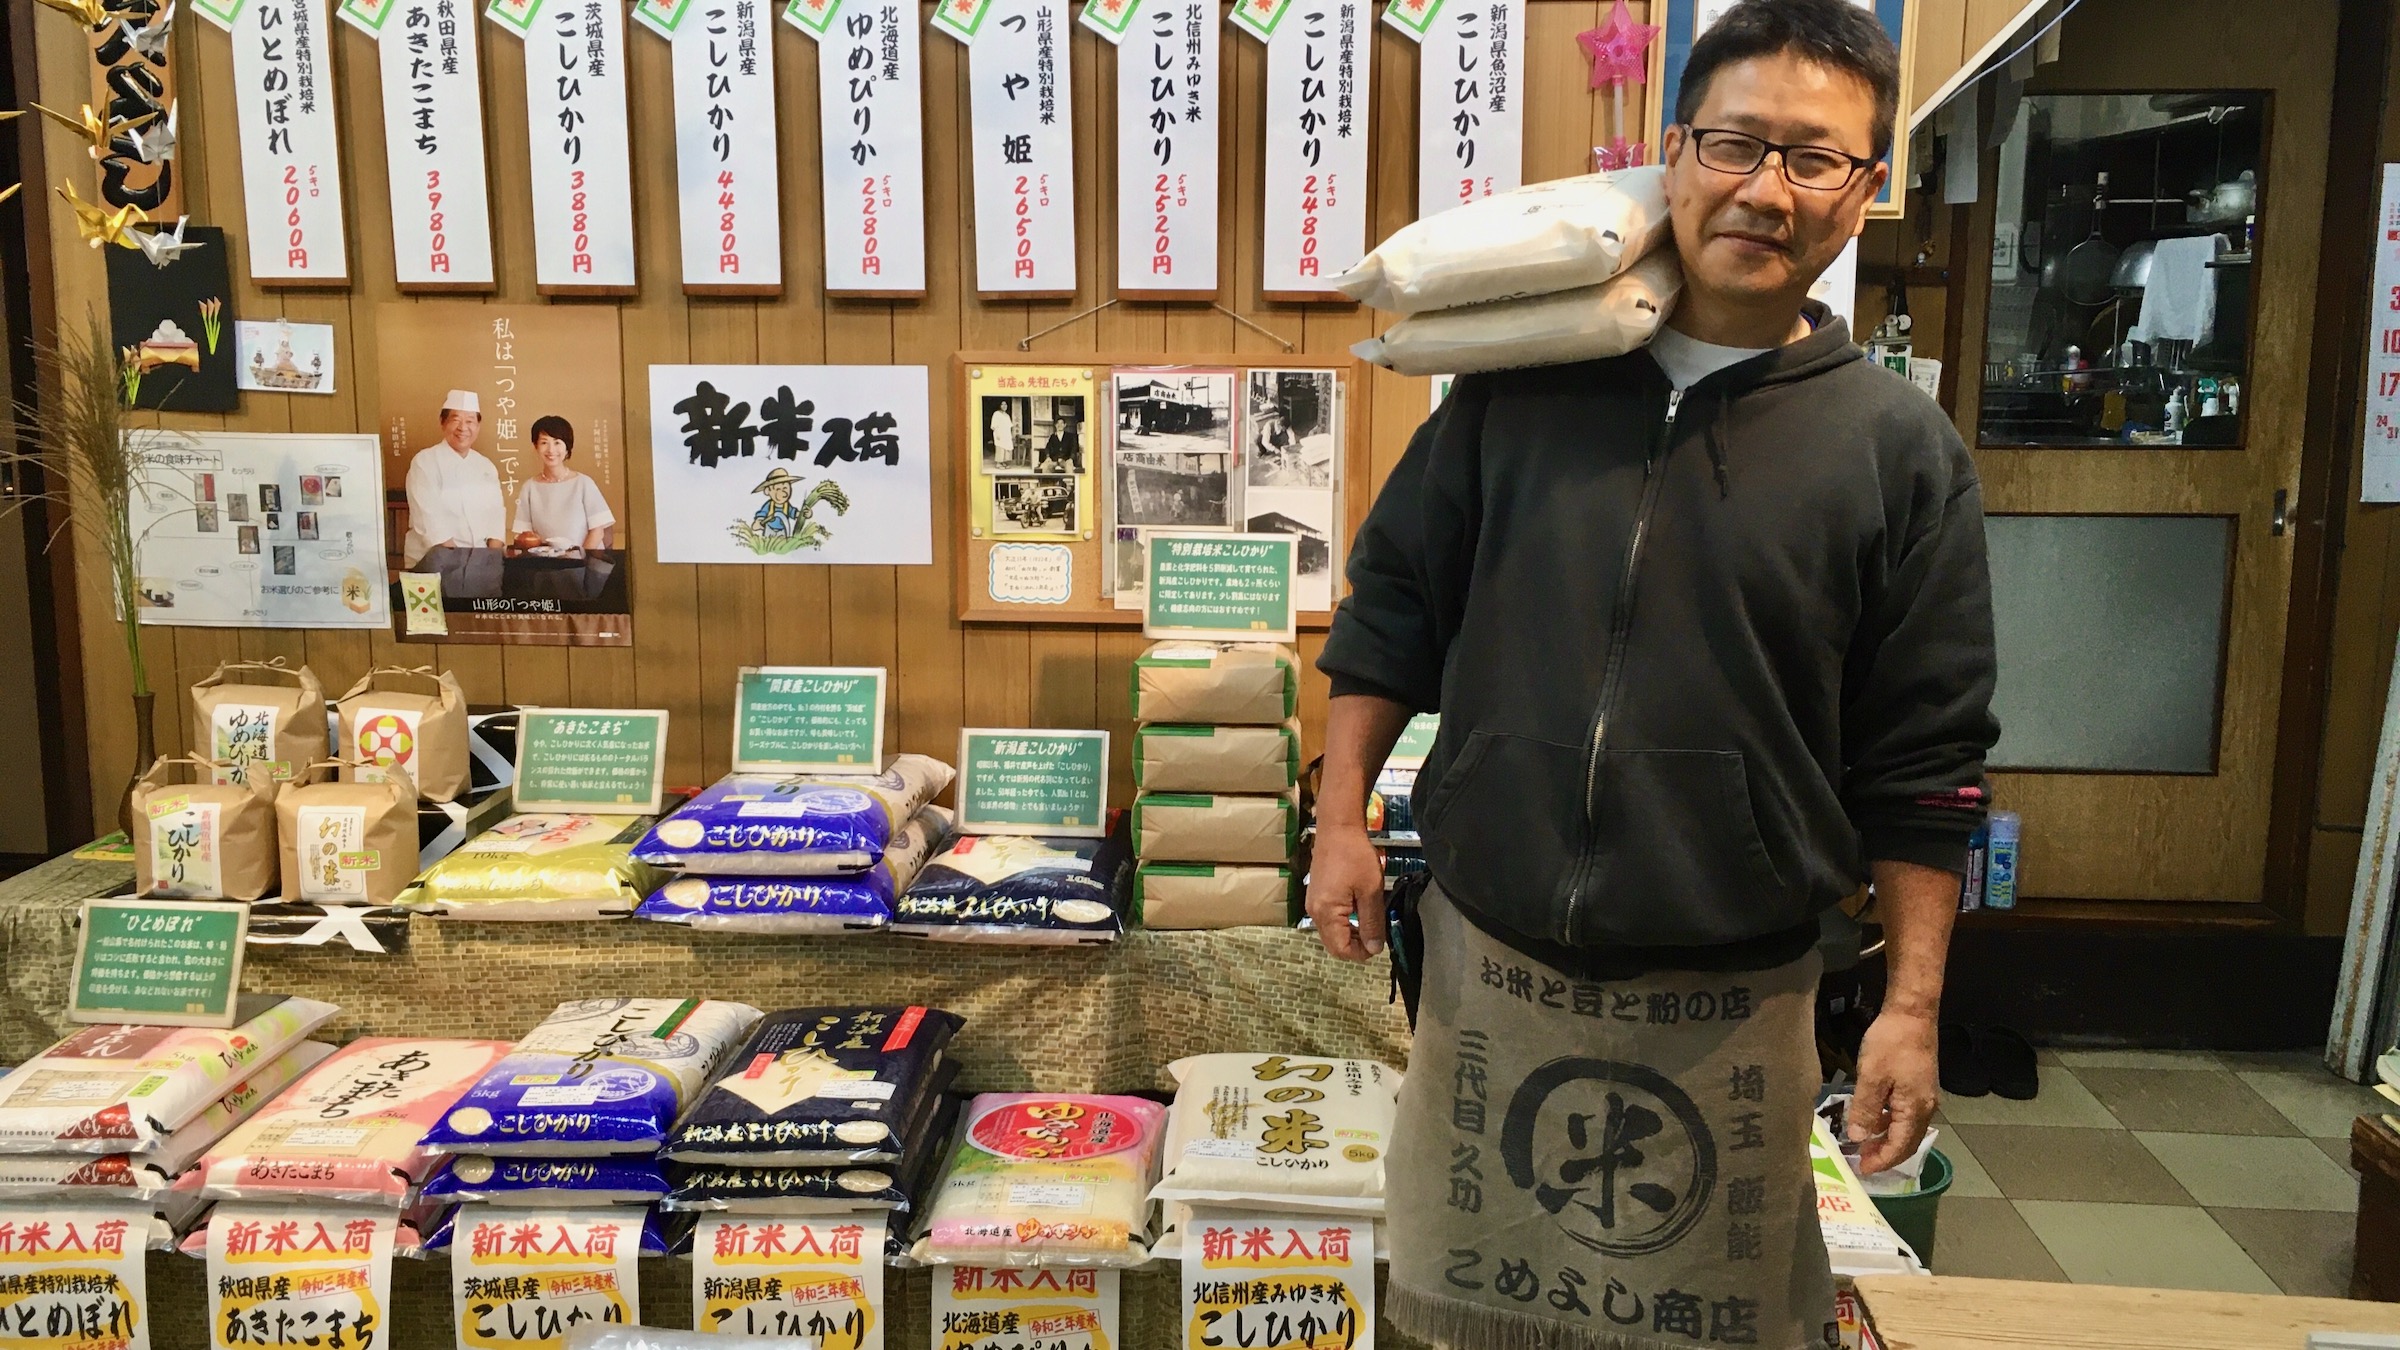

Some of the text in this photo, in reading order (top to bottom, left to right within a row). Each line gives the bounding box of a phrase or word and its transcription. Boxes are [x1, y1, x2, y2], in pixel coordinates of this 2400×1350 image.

[437, 0, 459, 74] 秋田県産
[584, 2, 605, 77] 茨城県産
[736, 1, 757, 76] 新潟県産
[880, 5, 900, 81] 北海道産
[1488, 4, 1509, 113] 新潟県魚沼産
[260, 5, 293, 154] ひとめぼれ
[406, 7, 438, 155] あきたこまち
[555, 11, 584, 165] こしひかり
[704, 8, 734, 162] こしひかり
[1036, 5, 1056, 126] 山形県産特別栽培米
[1184, 3, 1203, 123] 北信州みゆき米
[1337, 4, 1356, 138] 新潟県産特別栽培米
[846, 11, 878, 167] ゆめぴりか
[999, 13, 1032, 165] つや姫
[1149, 11, 1177, 168] こしひかり
[1300, 11, 1327, 168] こしひかり
[1455, 11, 1481, 169] こしひかり
[308, 165, 320, 197] 5キロ
[881, 174, 893, 208] 5キロ
[1038, 173, 1050, 208] 5キロ
[1177, 173, 1188, 209] 5キロ
[283, 165, 308, 269] 2060円
[427, 171, 450, 273] 3980円
[570, 170, 592, 274] 3880円
[717, 170, 739, 274] 4480円
[862, 177, 881, 276] 2280円
[1014, 174, 1034, 280] 2650円
[1152, 173, 1172, 276] 2520円
[1300, 174, 1320, 277] 2480円
[2379, 372, 2400, 396] 17
[492, 317, 521, 506] 私は「つや姫」です。
[673, 380, 900, 468] 新米入荷
[2376, 415, 2388, 427] 24
[472, 598, 563, 613] 山形の「つや姫」
[252, 711, 269, 762] 北海道
[151, 799, 186, 816] 新米
[319, 816, 342, 886] 幻の米
[341, 855, 377, 868] 新米
[707, 825, 816, 849] こしひかり
[713, 883, 822, 909] こしひかり
[1480, 955, 1752, 1025] お米と豆と粉の店
[566, 1007, 651, 1080] こしひかり
[320, 1050, 431, 1119] あきたこまち
[471, 1089, 501, 1099] 5kg
[1252, 1055, 1335, 1155] 幻の米
[500, 1113, 592, 1134] こしひかり
[1017, 1102, 1085, 1159] ゆめぴりか
[1089, 1111, 1116, 1144] 北海道産
[251, 1157, 335, 1180] あきたこまち
[503, 1163, 597, 1182] こしひかり
[1256, 1156, 1329, 1171] こしひかり
[1348, 1150, 1375, 1160] 5kg
[1536, 1091, 1678, 1230] 米
[227, 1220, 377, 1256] 新米入荷
[472, 1223, 620, 1259] 新米入荷
[715, 1224, 864, 1260] 新米入荷
[964, 1227, 1013, 1237] 北海道産
[1016, 1217, 1098, 1242] ゆめぴりか
[1202, 1226, 1353, 1263] 新米入荷
[218, 1276, 291, 1301] 秋田県産
[300, 1267, 369, 1296] 令和三年産米
[463, 1277, 541, 1301] 茨城県産
[549, 1273, 617, 1297] 令和三年産米
[704, 1277, 783, 1301] 新潟県産
[794, 1281, 862, 1304] 令和三年産米
[1193, 1281, 1346, 1306] 北信州産みゆき米
[1443, 1247, 1761, 1344] こめよし商店
[226, 1308, 375, 1350] あきたこまち
[942, 1311, 1020, 1335] 北海道産
[1031, 1312, 1099, 1337] 令和三年産米
[1199, 1308, 1357, 1350] こしひかり
